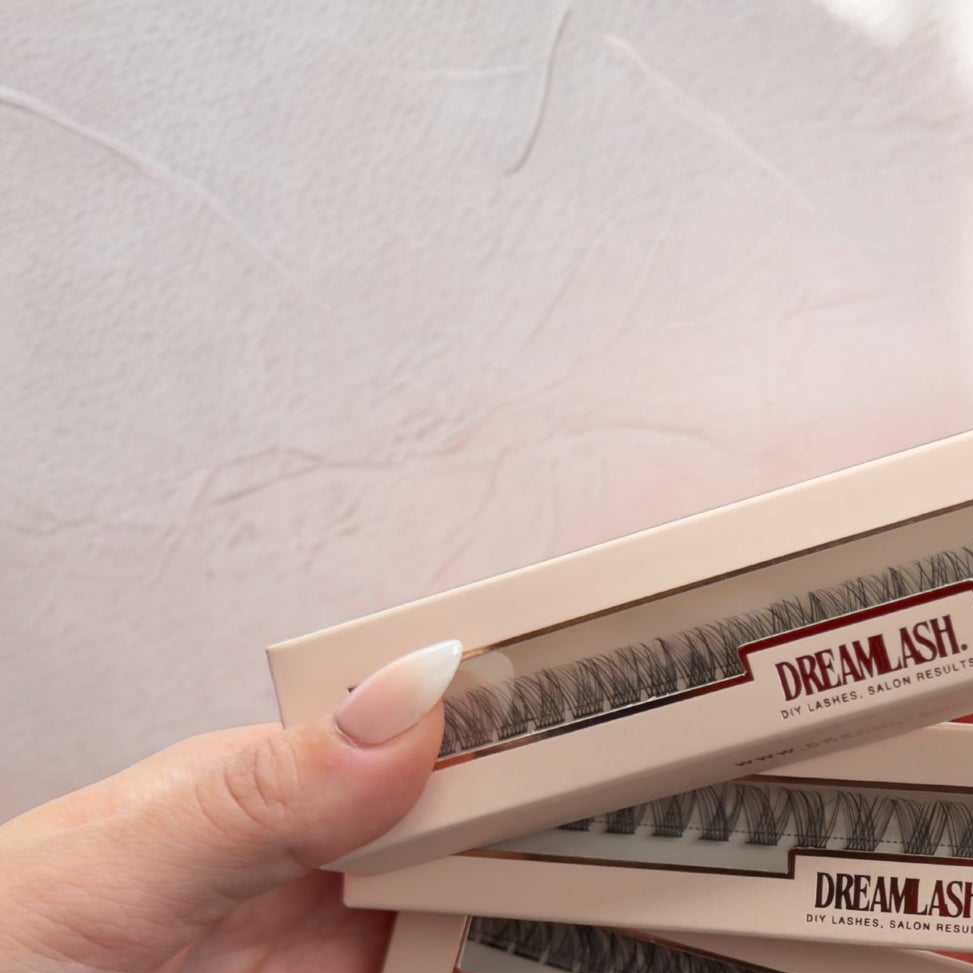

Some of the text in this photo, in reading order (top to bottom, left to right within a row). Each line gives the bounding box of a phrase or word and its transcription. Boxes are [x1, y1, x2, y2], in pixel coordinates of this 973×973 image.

[775, 615, 968, 701] DREAMLASH.
[780, 705, 802, 720] DIY
[808, 690, 864, 713] LASHES,
[868, 676, 912, 696] SALON
[806, 913, 826, 924] DIY
[831, 915, 885, 930] LASHES,
[889, 919, 931, 932] SALON
